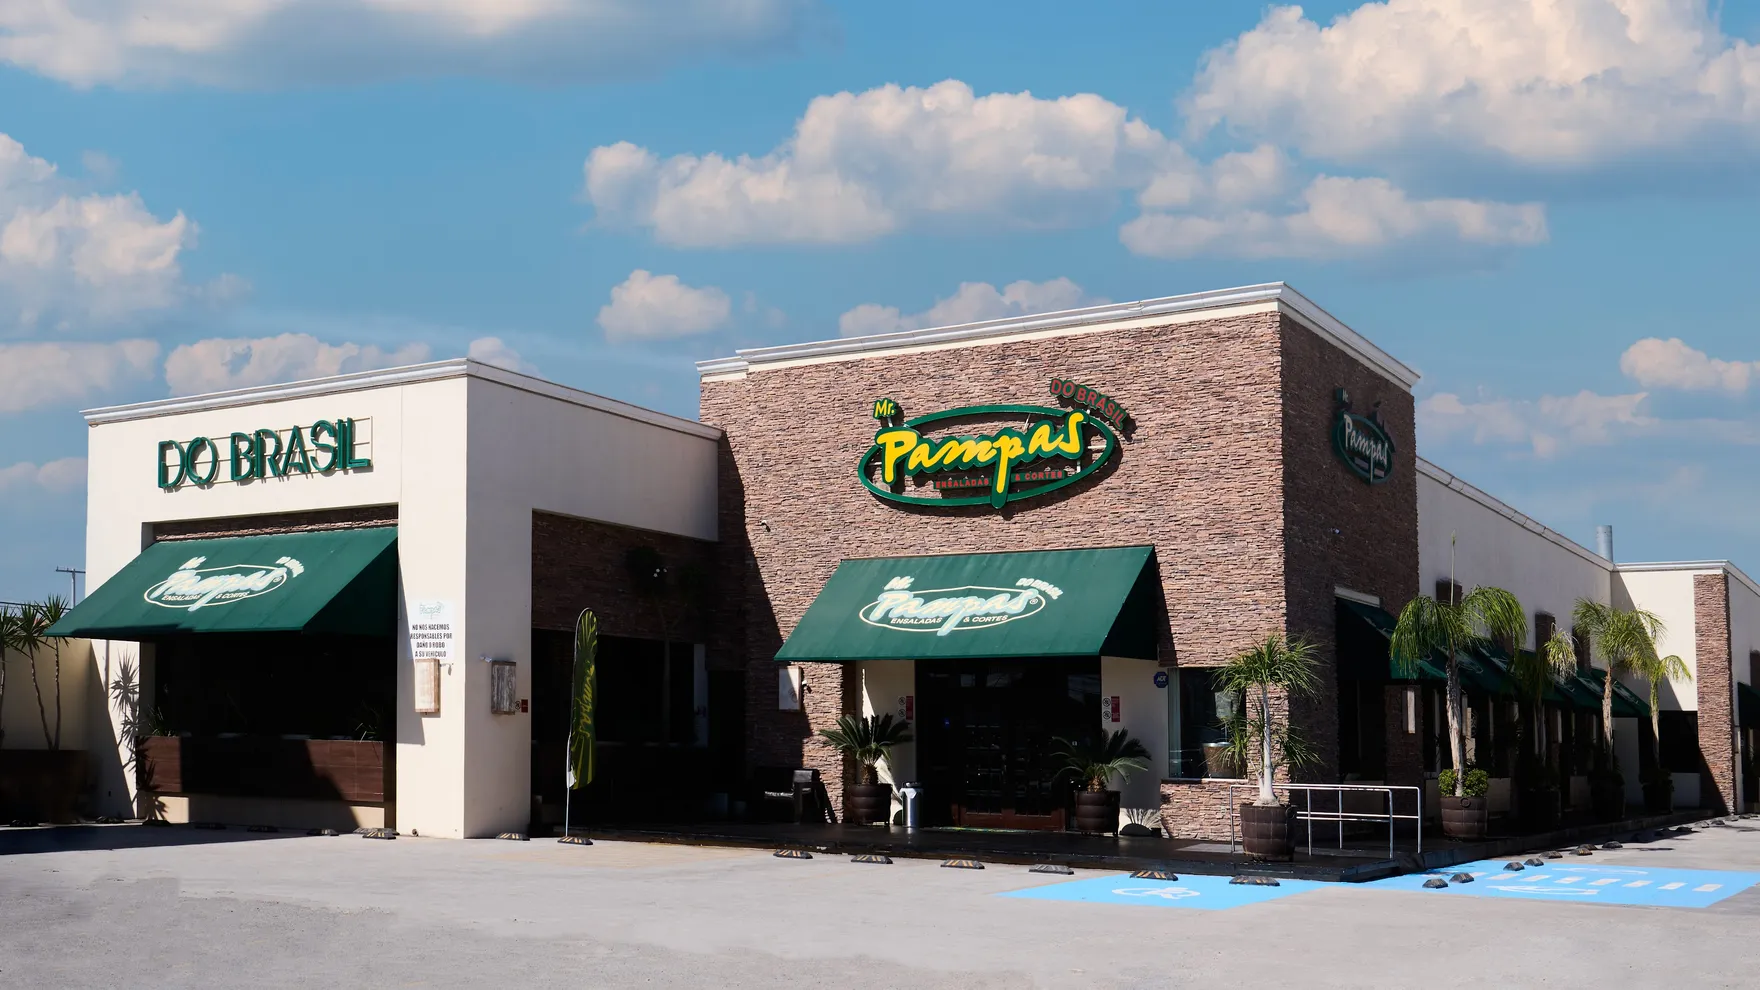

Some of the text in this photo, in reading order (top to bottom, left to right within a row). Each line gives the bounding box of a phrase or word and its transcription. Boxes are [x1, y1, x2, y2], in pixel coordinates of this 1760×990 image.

[874, 400, 896, 417] Mr.
[1051, 379, 1127, 429] DO BRASIL
[158, 417, 372, 488] DO BRASIL
[876, 412, 1085, 494] Pampas
[1343, 413, 1389, 482] Pampas
[935, 477, 990, 489] ENSALADAS
[1024, 470, 1063, 482] CORTES
[869, 588, 1039, 636] Pampas
[972, 615, 1009, 623] CORTES
